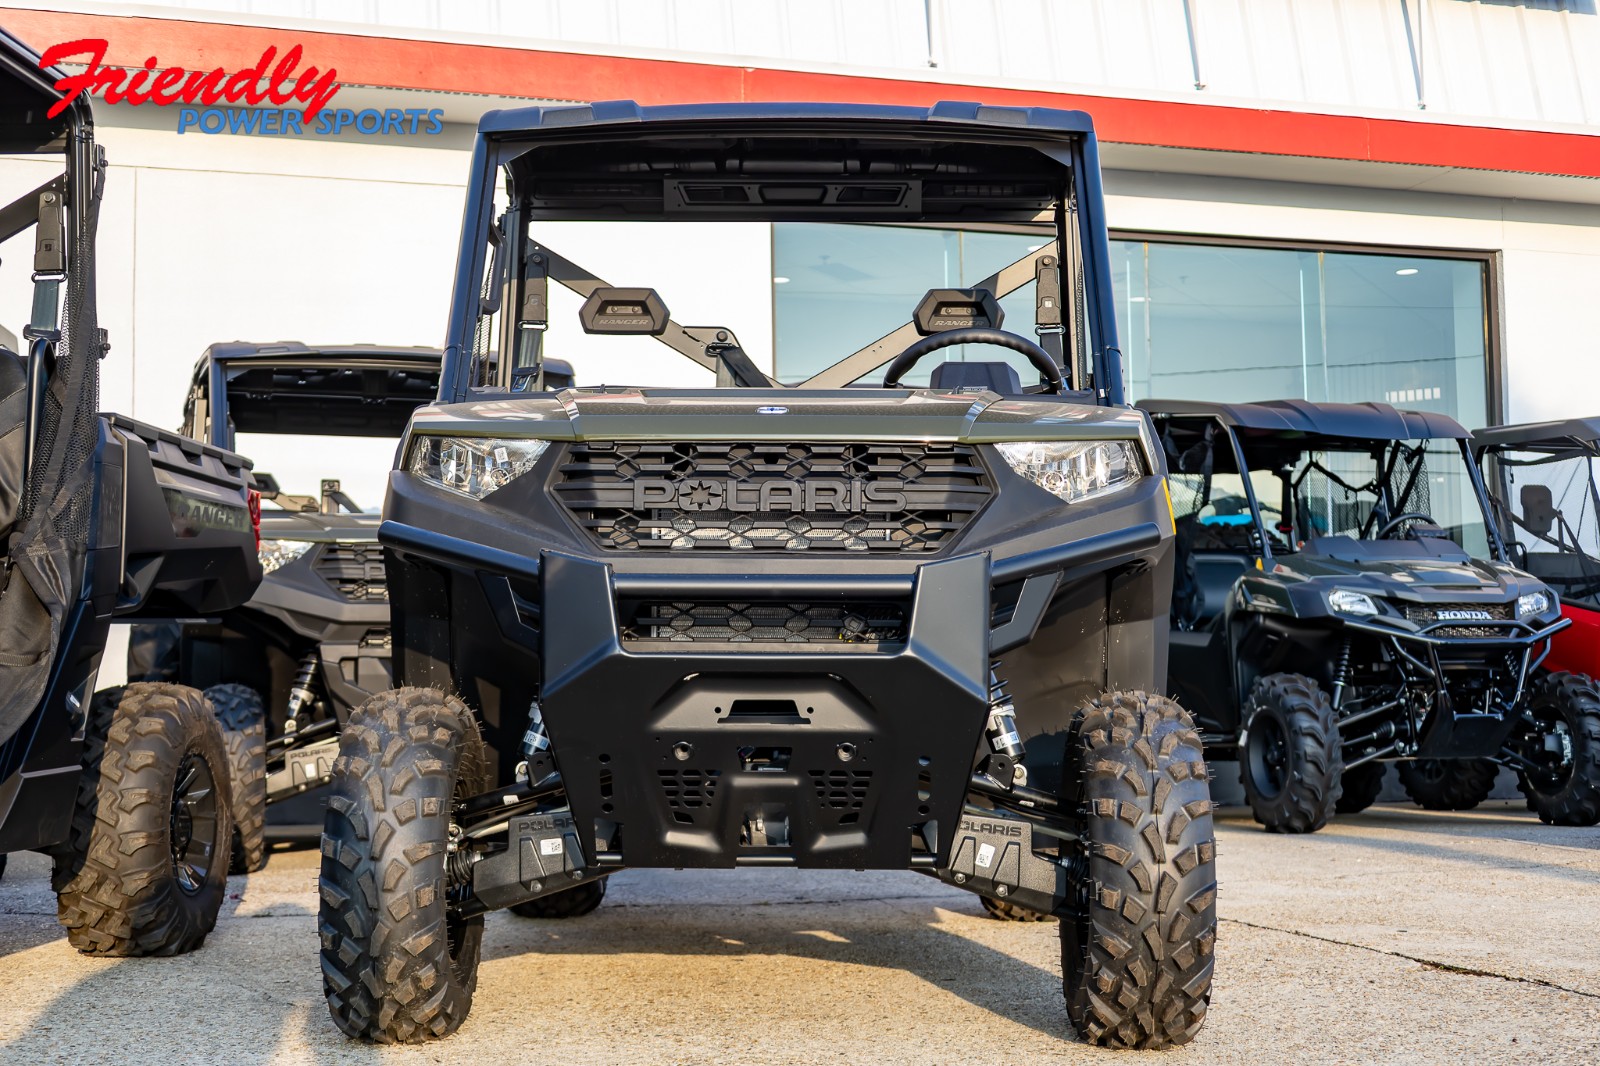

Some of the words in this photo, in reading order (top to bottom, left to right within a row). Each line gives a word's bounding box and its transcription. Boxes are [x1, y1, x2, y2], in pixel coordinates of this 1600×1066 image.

[633, 480, 908, 512] POLARIS
[178, 501, 245, 529] RANGER
[1436, 610, 1493, 620] HONDA
